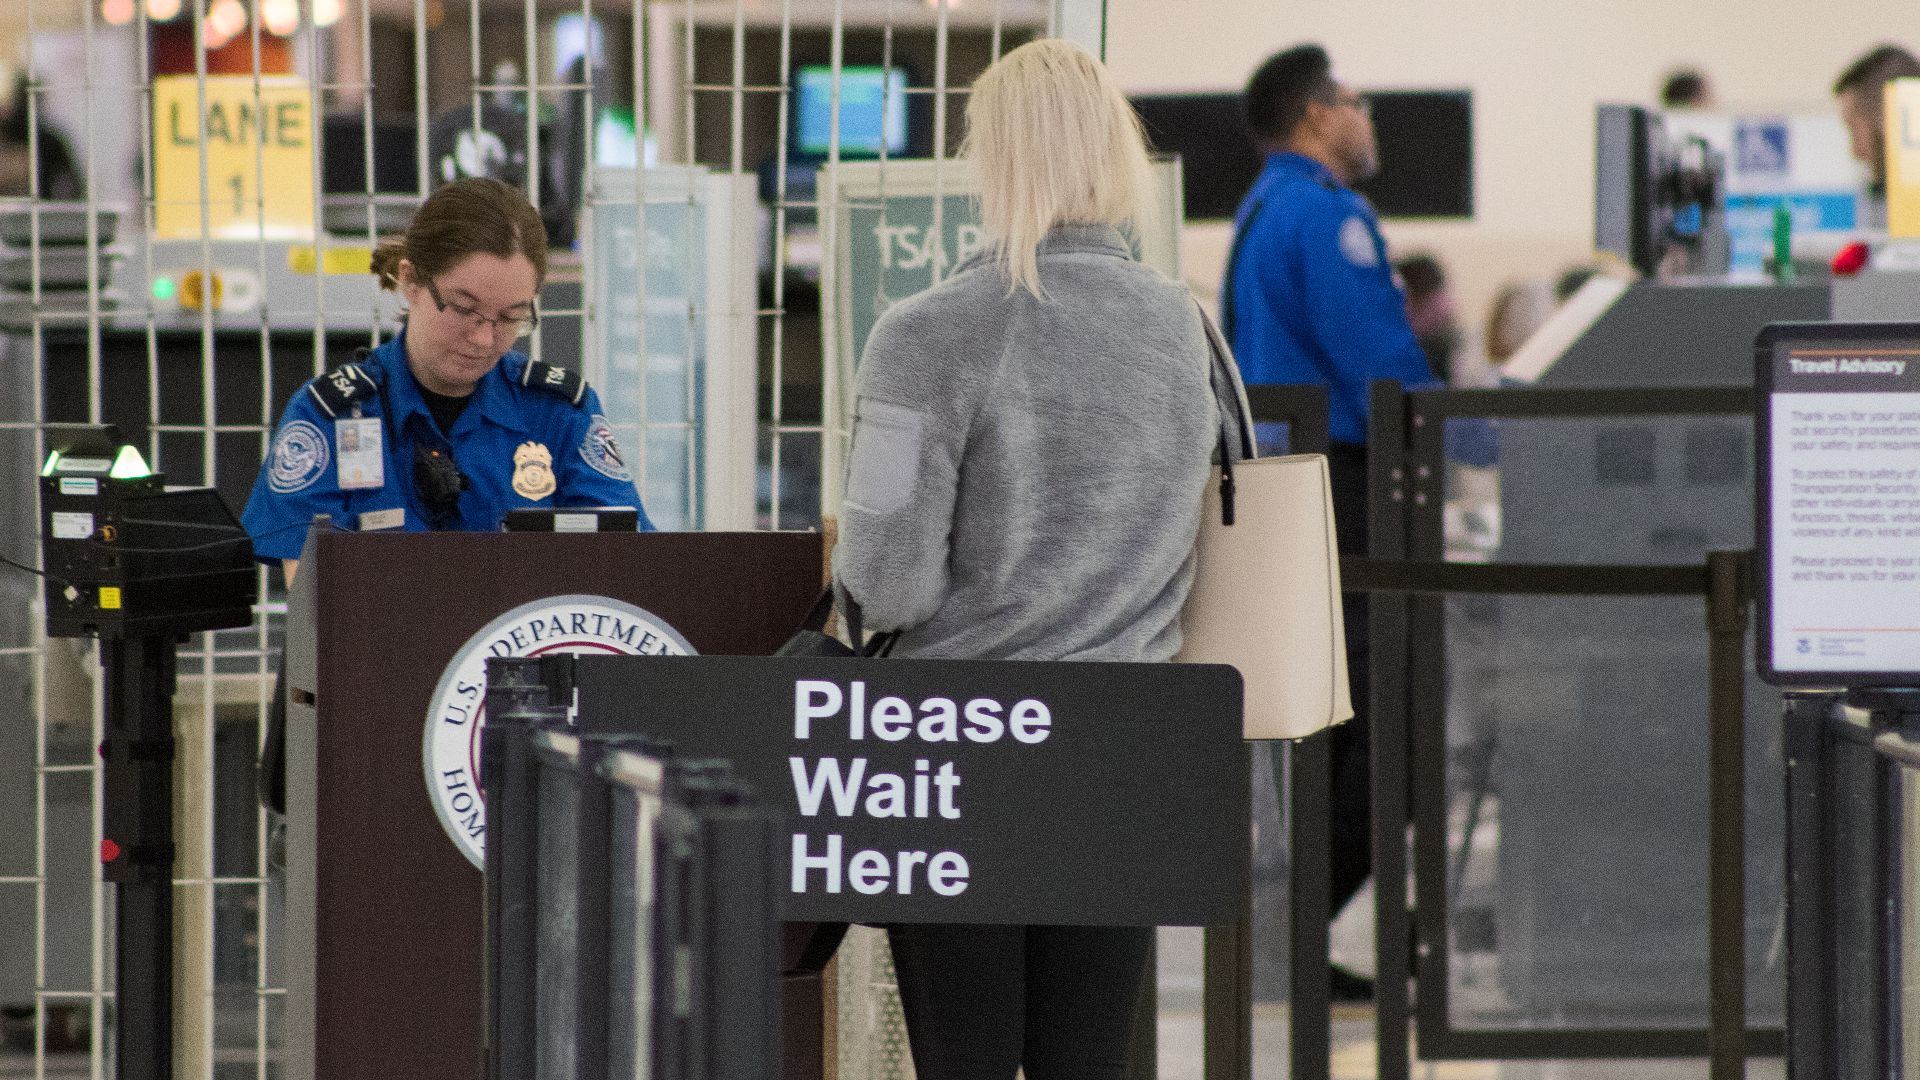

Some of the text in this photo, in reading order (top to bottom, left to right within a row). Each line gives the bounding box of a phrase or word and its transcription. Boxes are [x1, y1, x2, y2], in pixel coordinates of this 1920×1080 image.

[170, 100, 304, 147] LANE
[227, 171, 243, 216] 1
[873, 226, 948, 268] TSA
[329, 370, 356, 398] TSA
[545, 366, 567, 385] TSA
[1789, 358, 1906, 376] Travel Advisory
[1791, 410, 1823, 421] Thank
[445, 681, 484, 727] U.S.
[794, 680, 1052, 744] Please
[788, 756, 962, 820] Wait
[791, 833, 970, 896] Here
